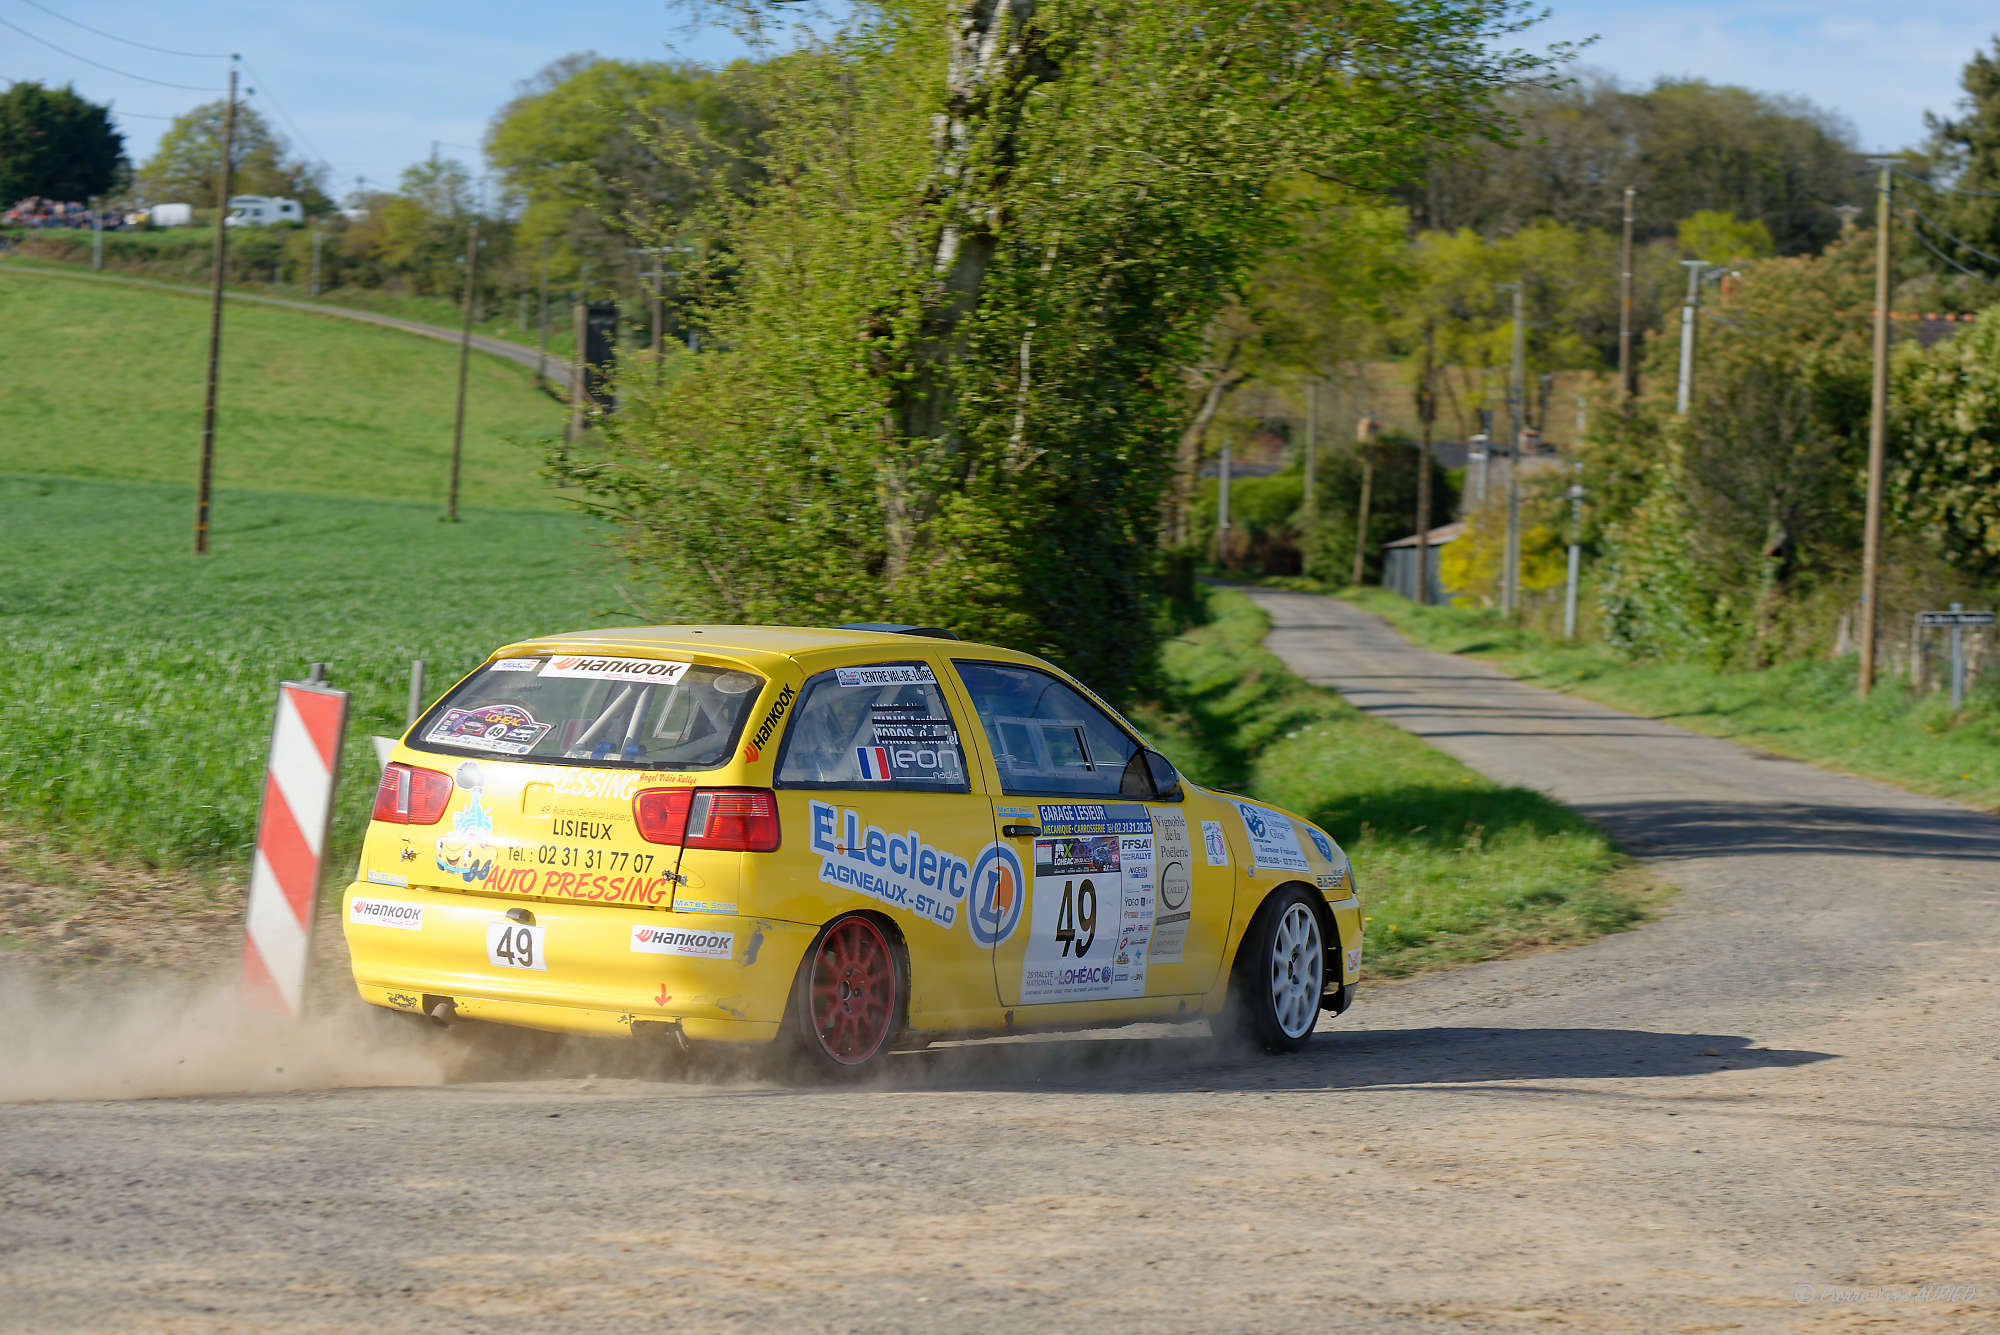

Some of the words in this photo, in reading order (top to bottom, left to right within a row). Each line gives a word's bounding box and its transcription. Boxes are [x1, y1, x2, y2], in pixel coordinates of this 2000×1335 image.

[860, 671, 886, 683] CENTRE
[488, 727, 503, 737] 49
[1041, 805, 1074, 821] GARAGE
[1074, 804, 1106, 821] LESIEUR
[1154, 815, 1185, 828] Vignoble
[552, 818, 613, 841] LISIEUX
[1165, 830, 1173, 841] de
[1173, 830, 1181, 841] la
[1122, 839, 1149, 850] FFSA
[538, 845, 556, 865] 02
[562, 847, 578, 867] 31
[585, 849, 602, 870] 31
[610, 851, 629, 873] 77
[633, 853, 655, 874] 07
[1131, 852, 1151, 860] RALLYE
[483, 865, 537, 893] AUTO
[541, 870, 667, 905] PRESSING
[1055, 879, 1097, 958] 49
[496, 926, 533, 967] 49
